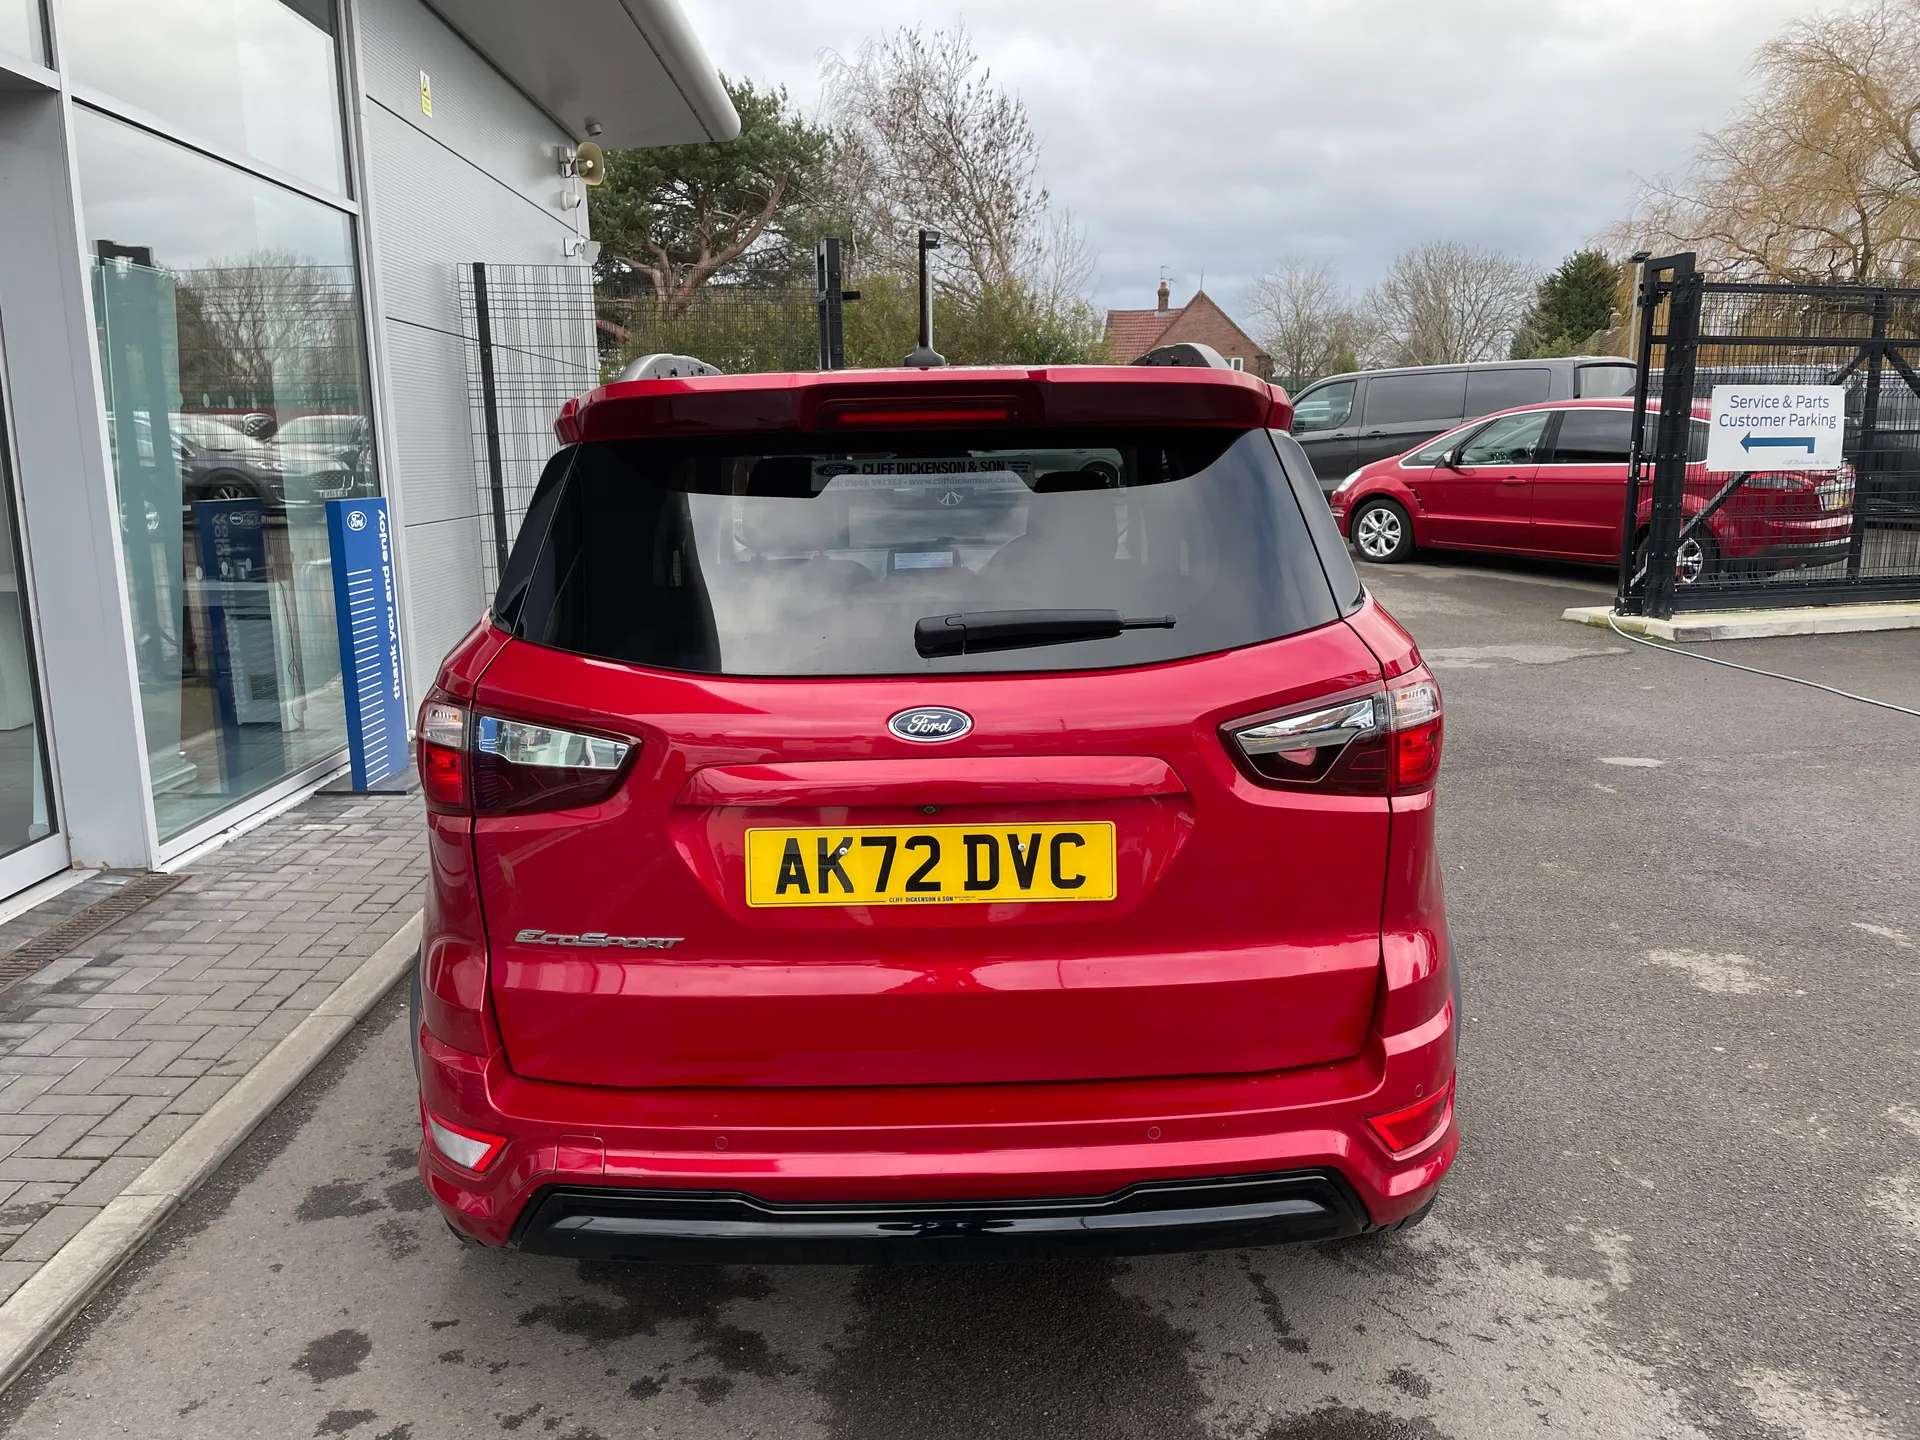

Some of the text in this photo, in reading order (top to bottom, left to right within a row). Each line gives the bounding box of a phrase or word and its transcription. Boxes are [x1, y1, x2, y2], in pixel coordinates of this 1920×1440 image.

[1729, 394, 1830, 409] Service & Parts
[1719, 413, 1837, 429] Customer Parking
[861, 461, 895, 475] CLIFF
[899, 460, 966, 475] DICKENSON
[967, 460, 978, 473] &
[979, 460, 1005, 473] SON
[377, 509, 401, 701] thank you and enjoy
[907, 714, 953, 733] Ford
[774, 832, 1087, 896] AK72 DVC
